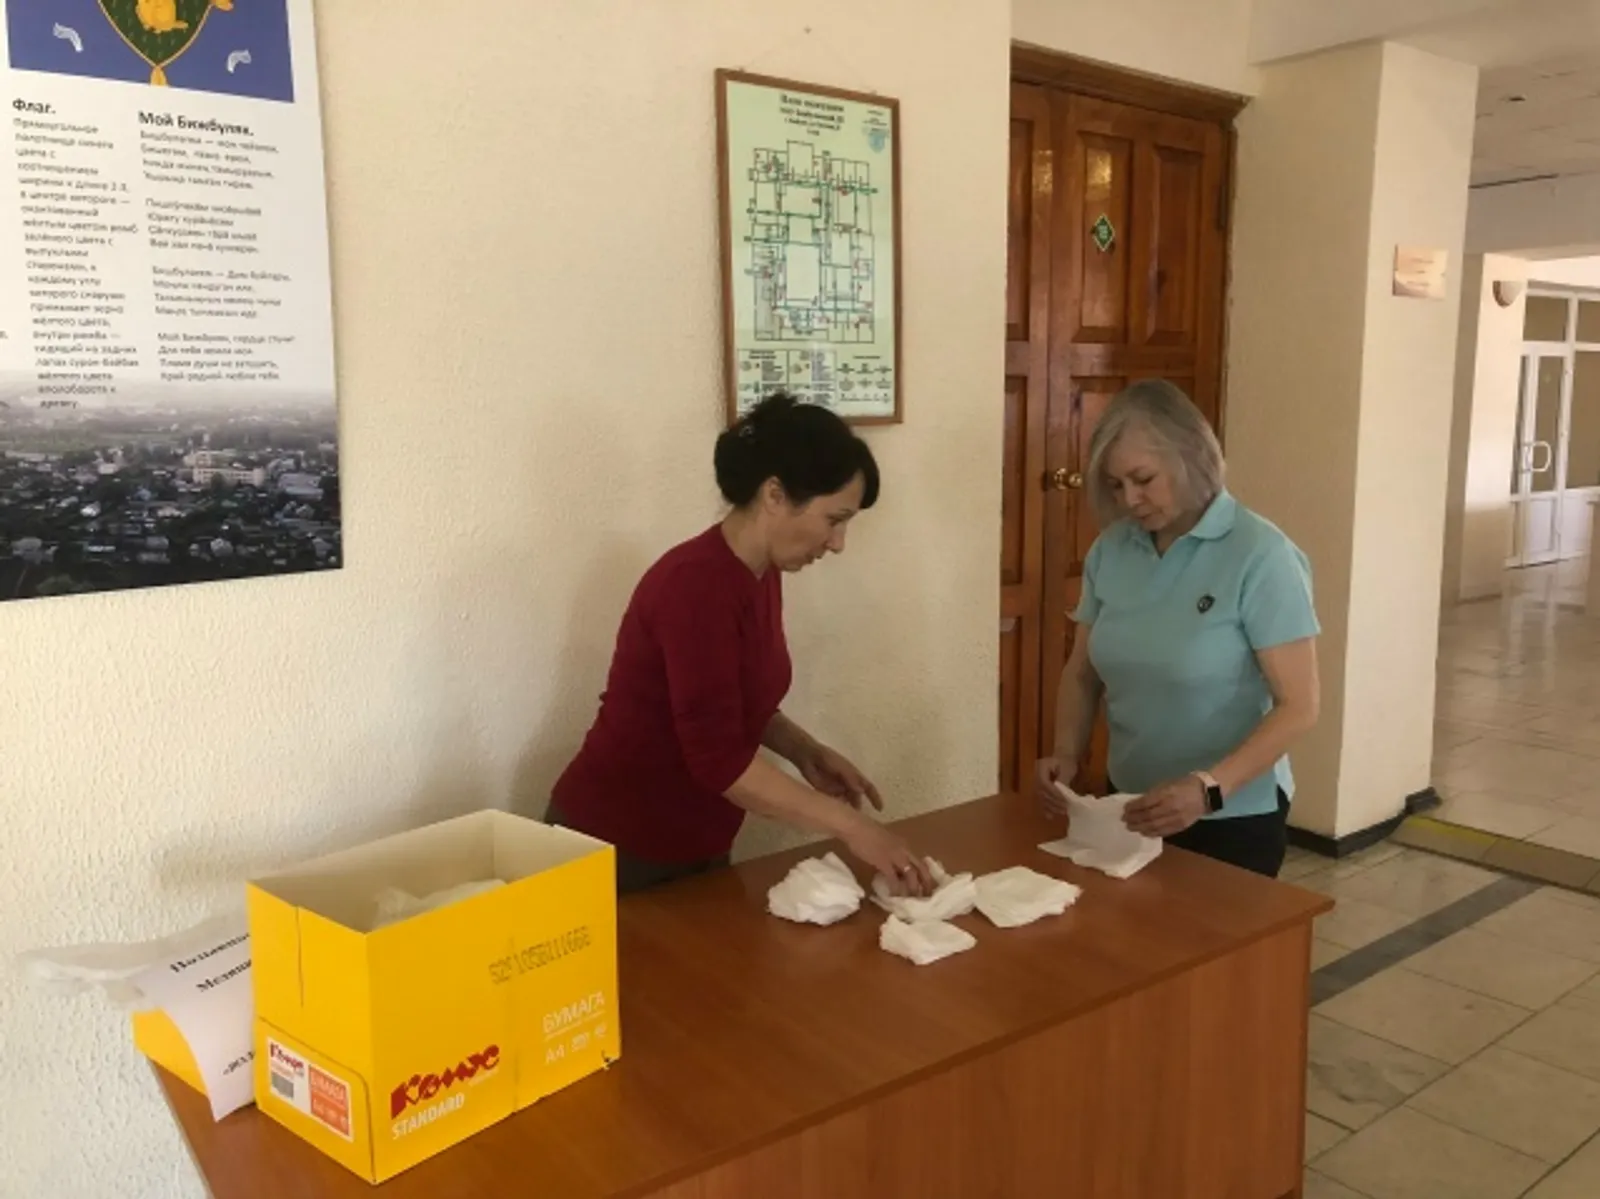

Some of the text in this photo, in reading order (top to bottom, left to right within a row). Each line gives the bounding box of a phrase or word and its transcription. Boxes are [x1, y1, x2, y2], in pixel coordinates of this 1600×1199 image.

[12, 98, 56, 114] Флаг.
[138, 110, 254, 136] Мой Бижбуляк.
[392, 1092, 464, 1140] STANDARD
